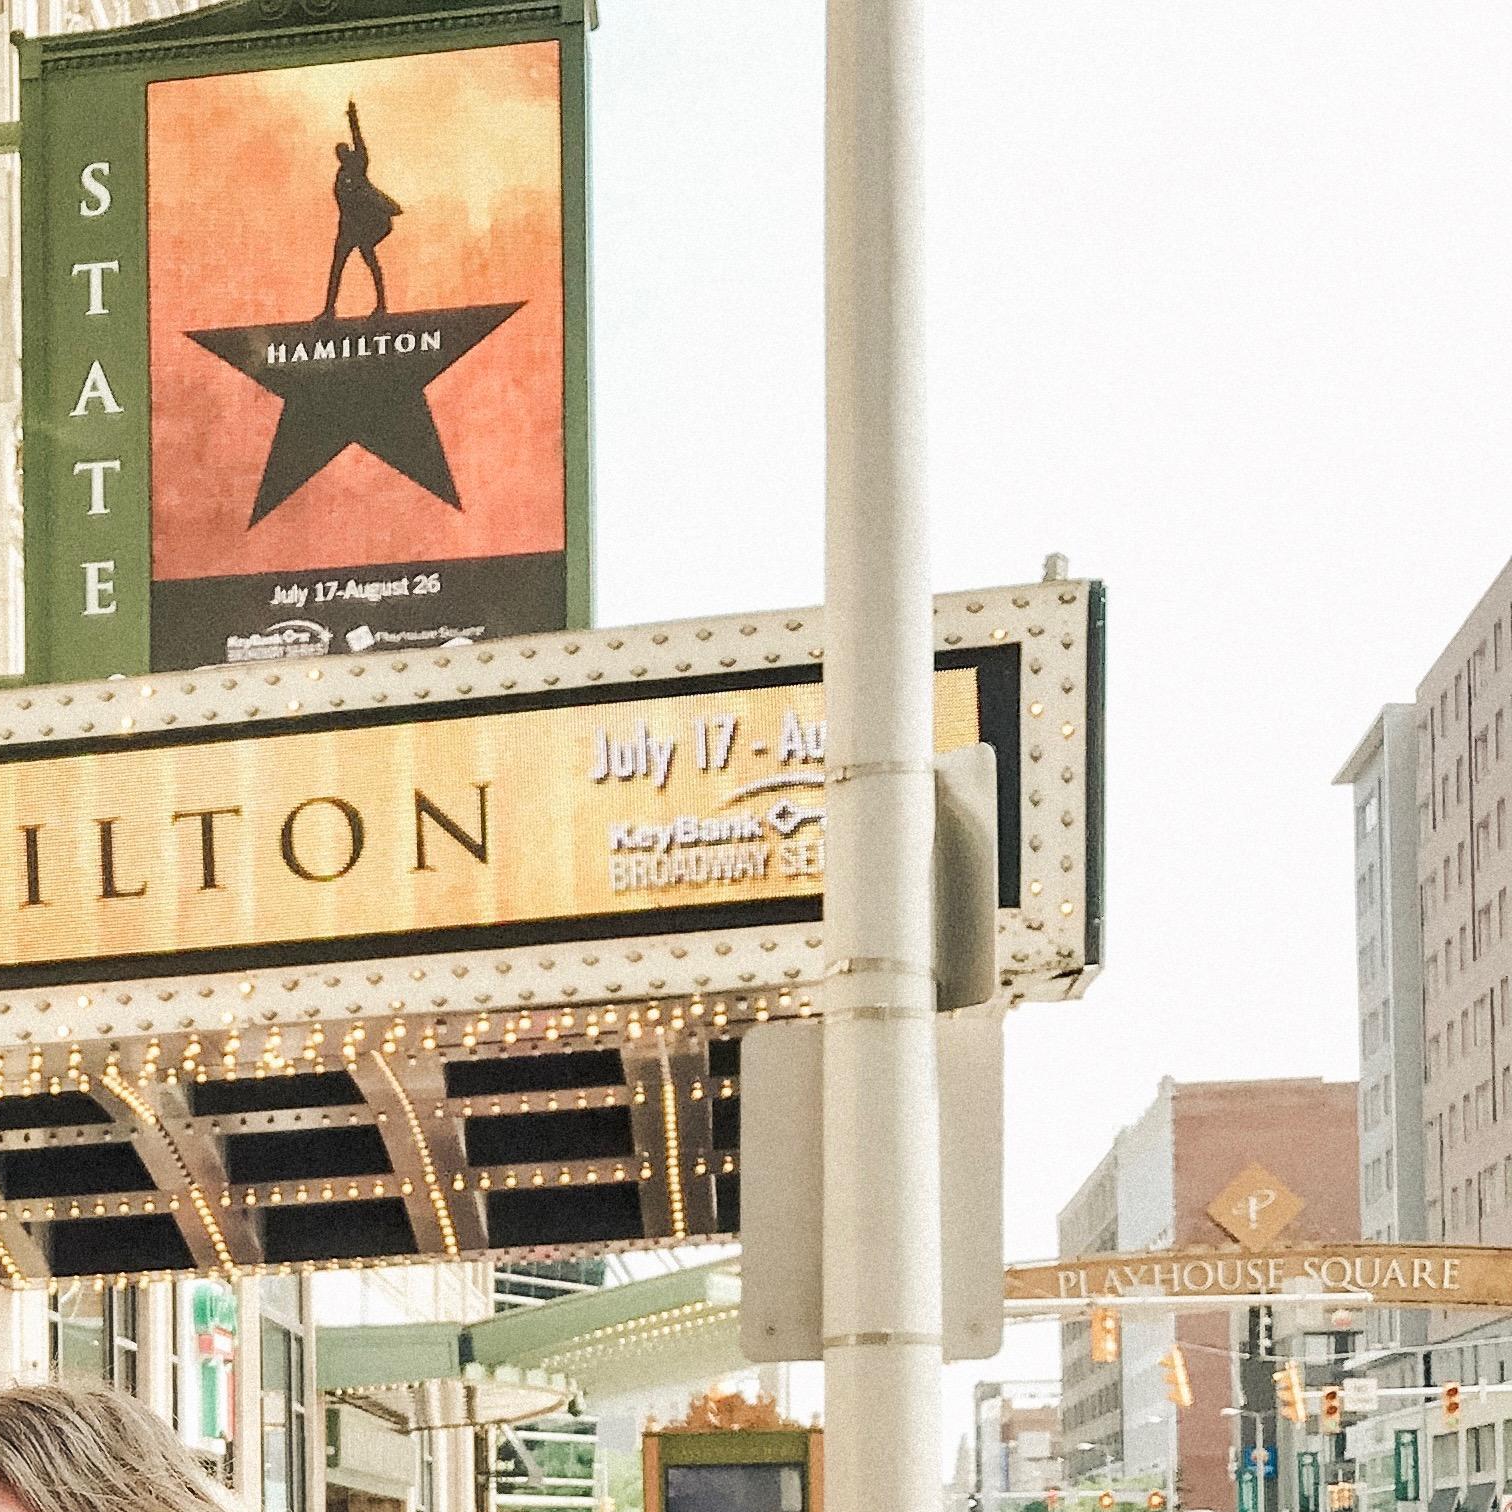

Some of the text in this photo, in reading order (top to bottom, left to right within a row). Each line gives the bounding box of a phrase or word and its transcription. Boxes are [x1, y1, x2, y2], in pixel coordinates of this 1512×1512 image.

[267, 329, 442, 364] HAMILTON
[68, 160, 125, 617] STATE
[270, 572, 441, 608] July 17-August 26
[589, 717, 676, 789] July
[694, 713, 738, 771] 17
[609, 812, 764, 853] KeyBank
[609, 845, 769, 892] BROADWAY
[1056, 1256, 1461, 1299] PLAYHOUSE SQUARE
